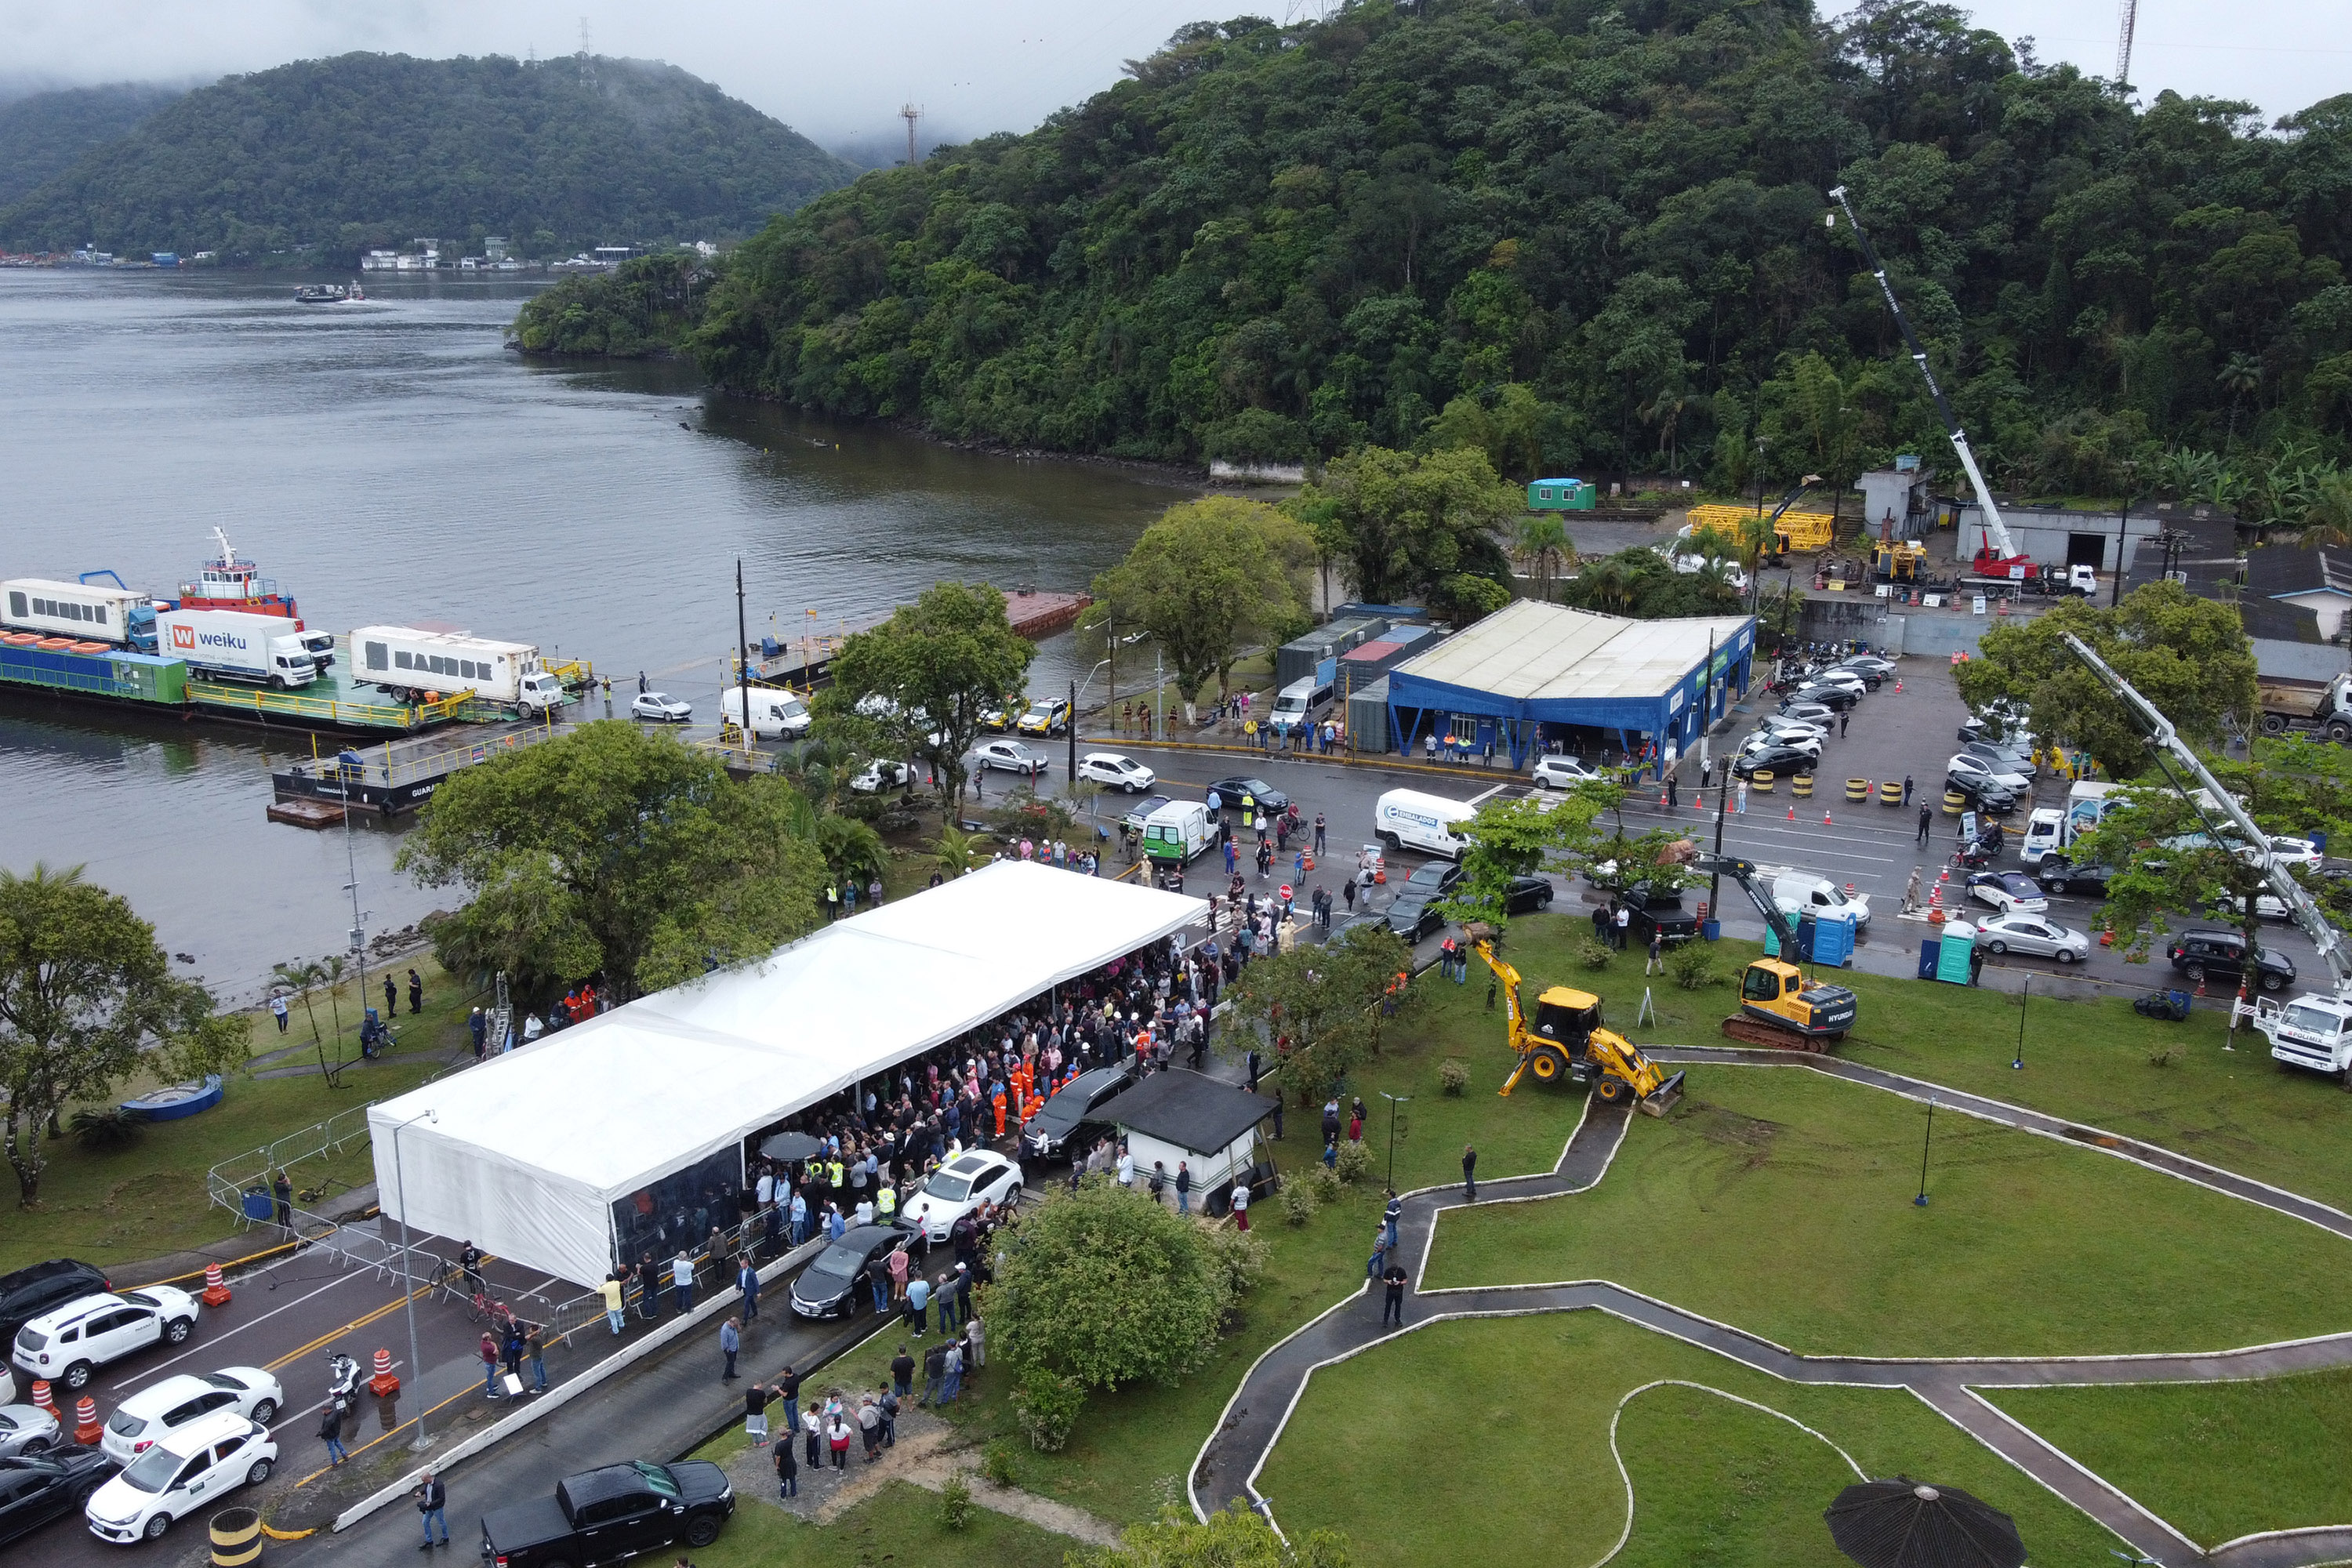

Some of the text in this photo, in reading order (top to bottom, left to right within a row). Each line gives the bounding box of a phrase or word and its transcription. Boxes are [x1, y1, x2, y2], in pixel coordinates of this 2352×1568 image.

[174, 628, 193, 645] W
[199, 632, 247, 650] weiku
[1399, 810, 1436, 826] EMBALADOS
[1748, 890, 1768, 915] HYUNDAI
[1828, 1009, 1853, 1022] HYUNDAI
[2292, 1031, 2323, 1044] POLIMIX
[1594, 1042, 1609, 1053] JCB
